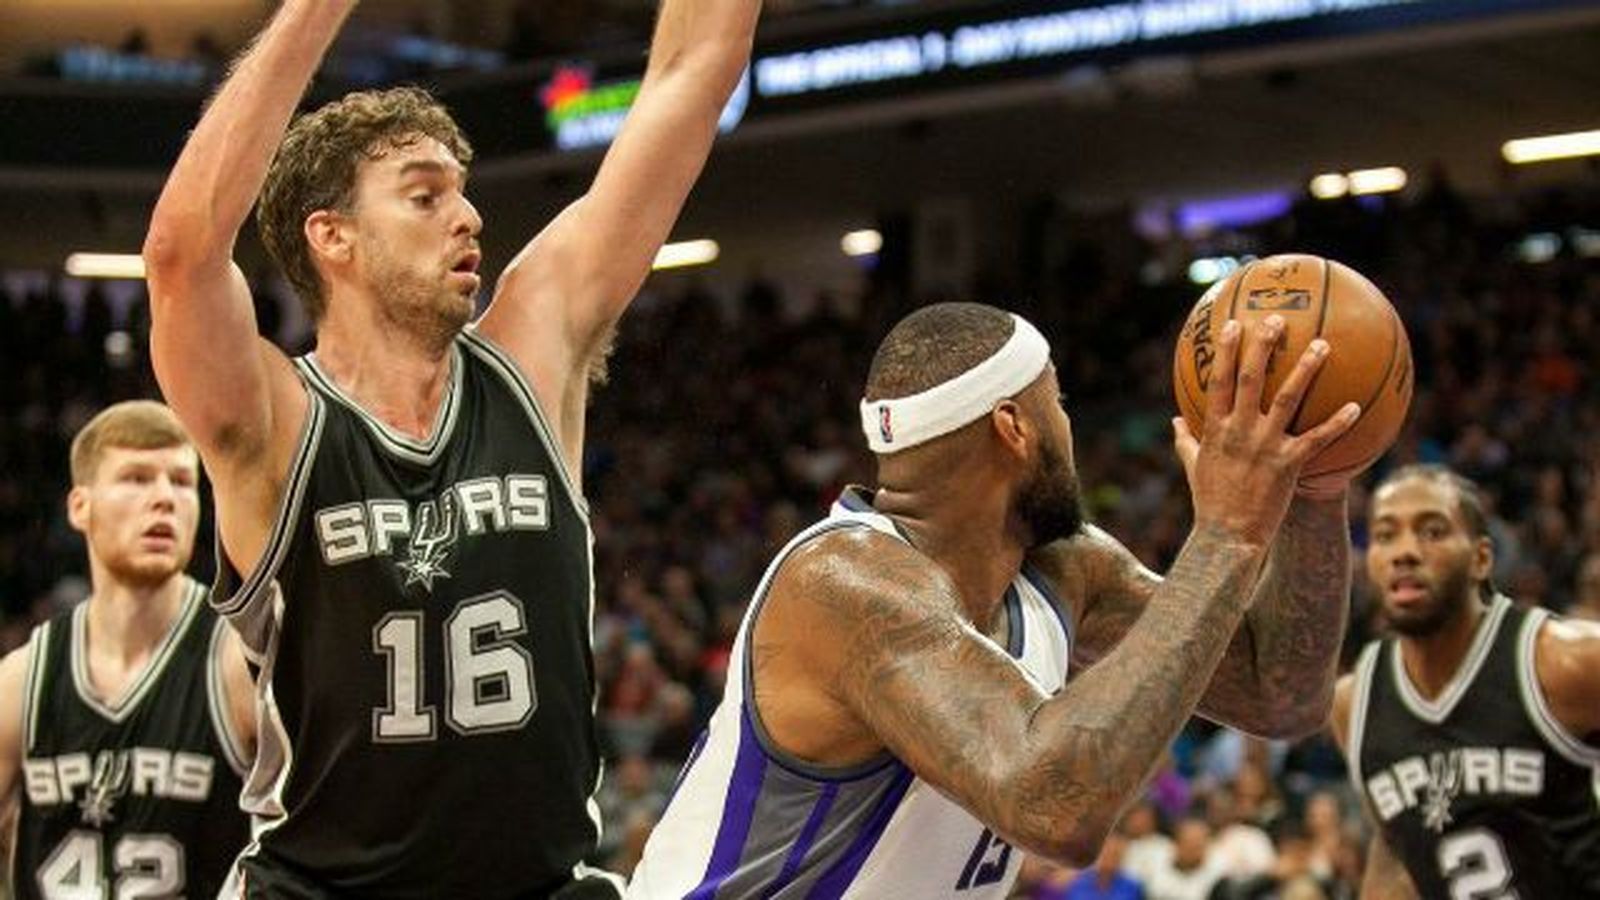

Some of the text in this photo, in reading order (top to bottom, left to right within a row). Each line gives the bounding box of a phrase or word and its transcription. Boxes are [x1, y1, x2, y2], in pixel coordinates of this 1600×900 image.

[315, 474, 550, 590] SPURS
[372, 589, 538, 742] 16
[24, 747, 215, 824] SPURS
[1368, 747, 1544, 830] SPURS
[36, 829, 187, 900] 42
[1438, 827, 1520, 900] 2
